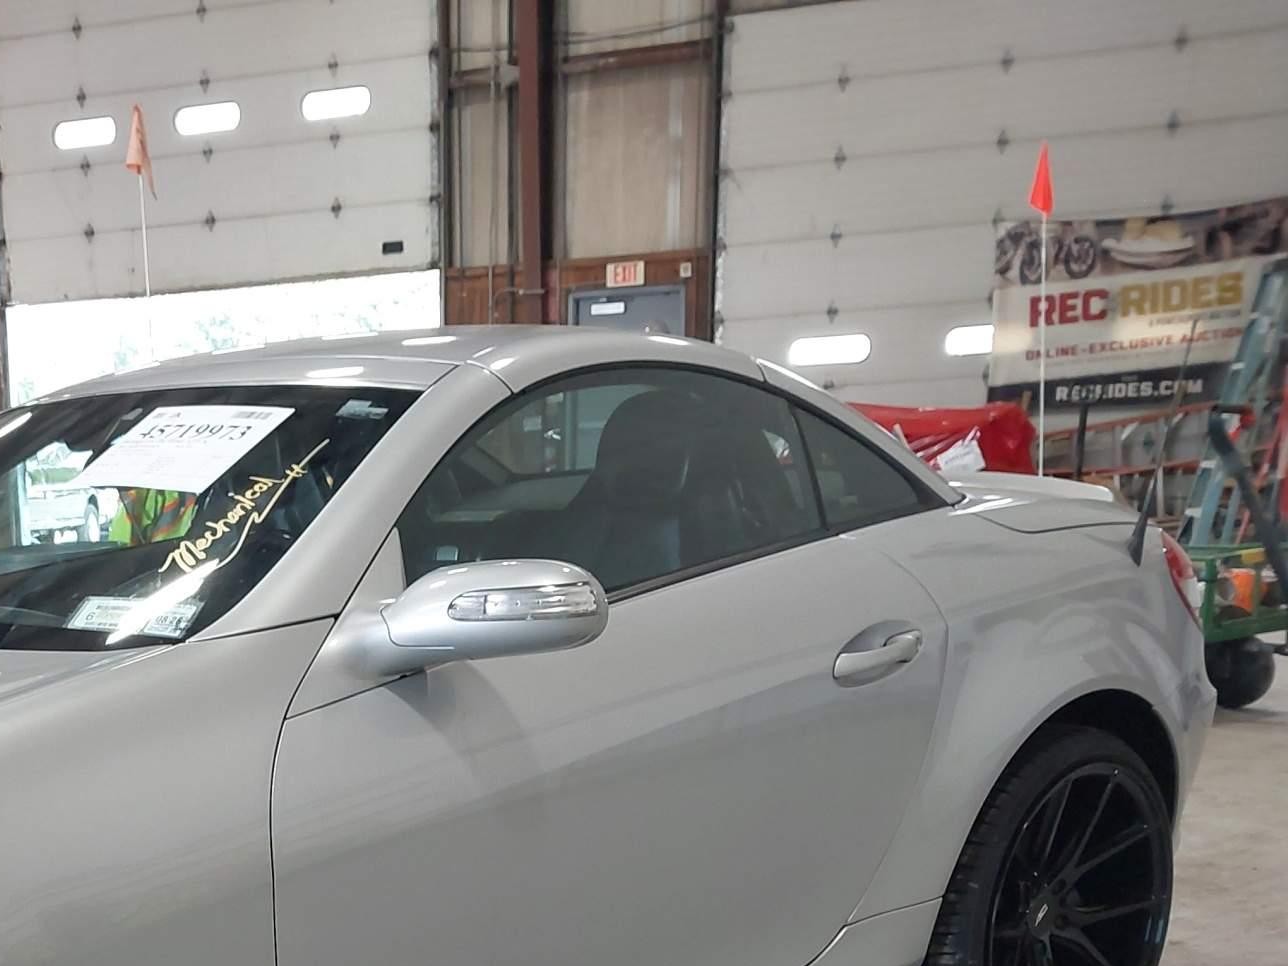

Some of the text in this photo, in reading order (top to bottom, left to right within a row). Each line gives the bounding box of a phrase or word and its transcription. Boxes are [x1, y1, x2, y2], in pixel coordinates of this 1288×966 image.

[613, 263, 638, 284] EXIT
[1029, 289, 1109, 328] REC
[1120, 272, 1243, 318] RIDES
